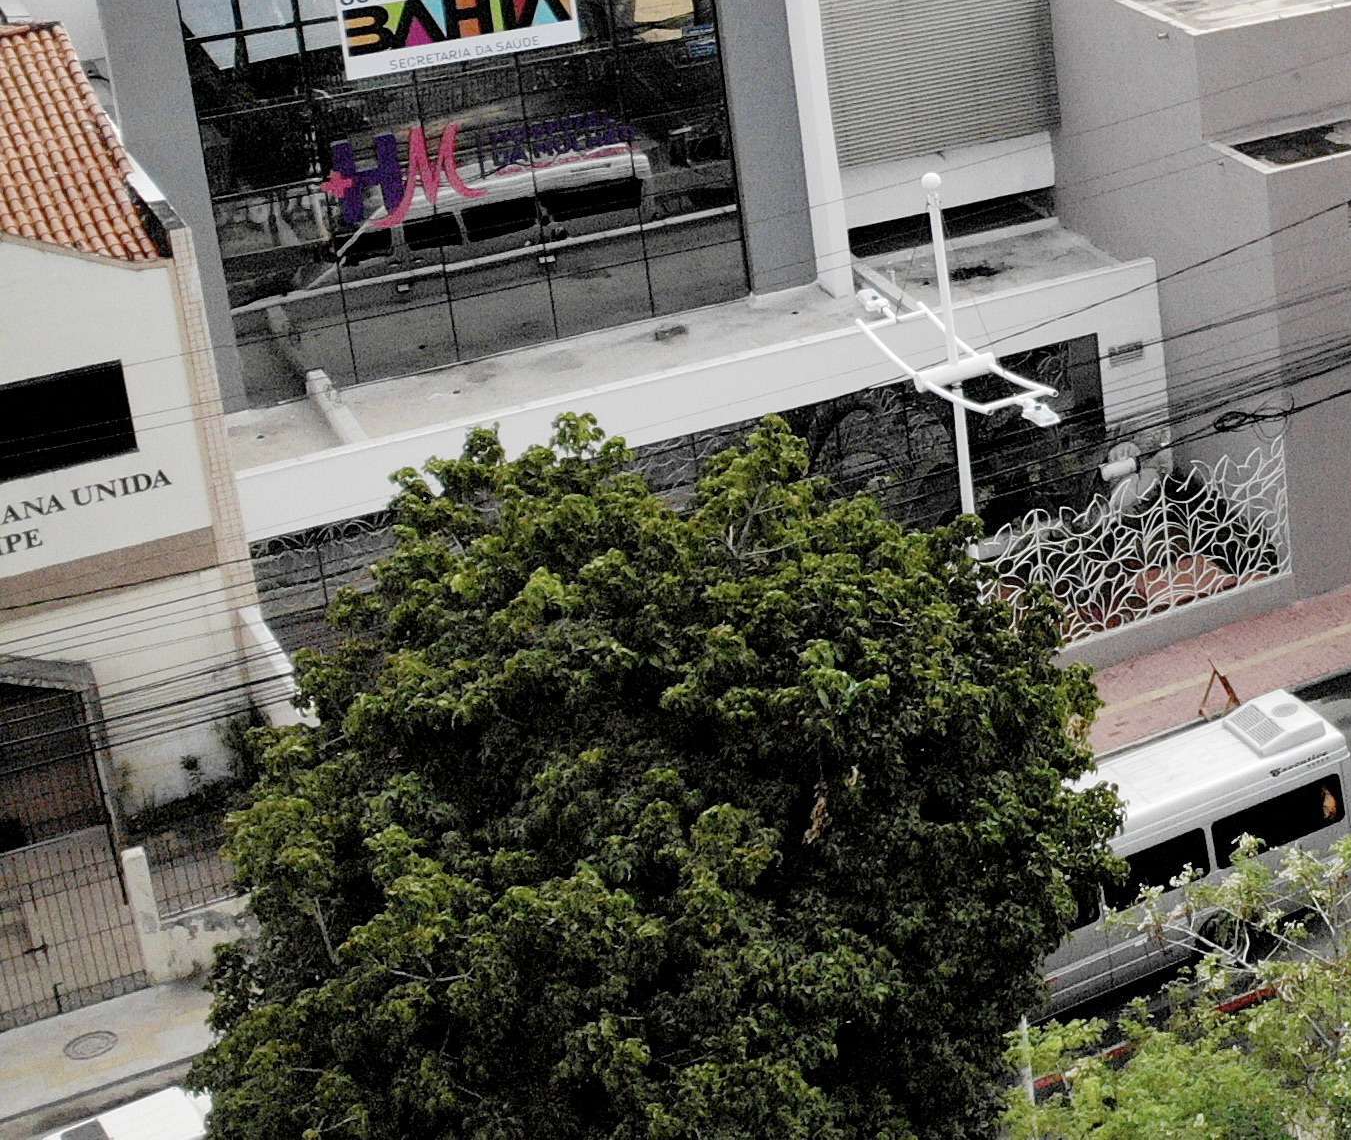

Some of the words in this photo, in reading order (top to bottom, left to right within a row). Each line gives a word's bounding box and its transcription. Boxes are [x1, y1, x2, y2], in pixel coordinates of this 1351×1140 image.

[389, 48, 472, 71] SECRETARIA
[475, 44, 493, 57] DA
[70, 469, 172, 507] UNIDA
